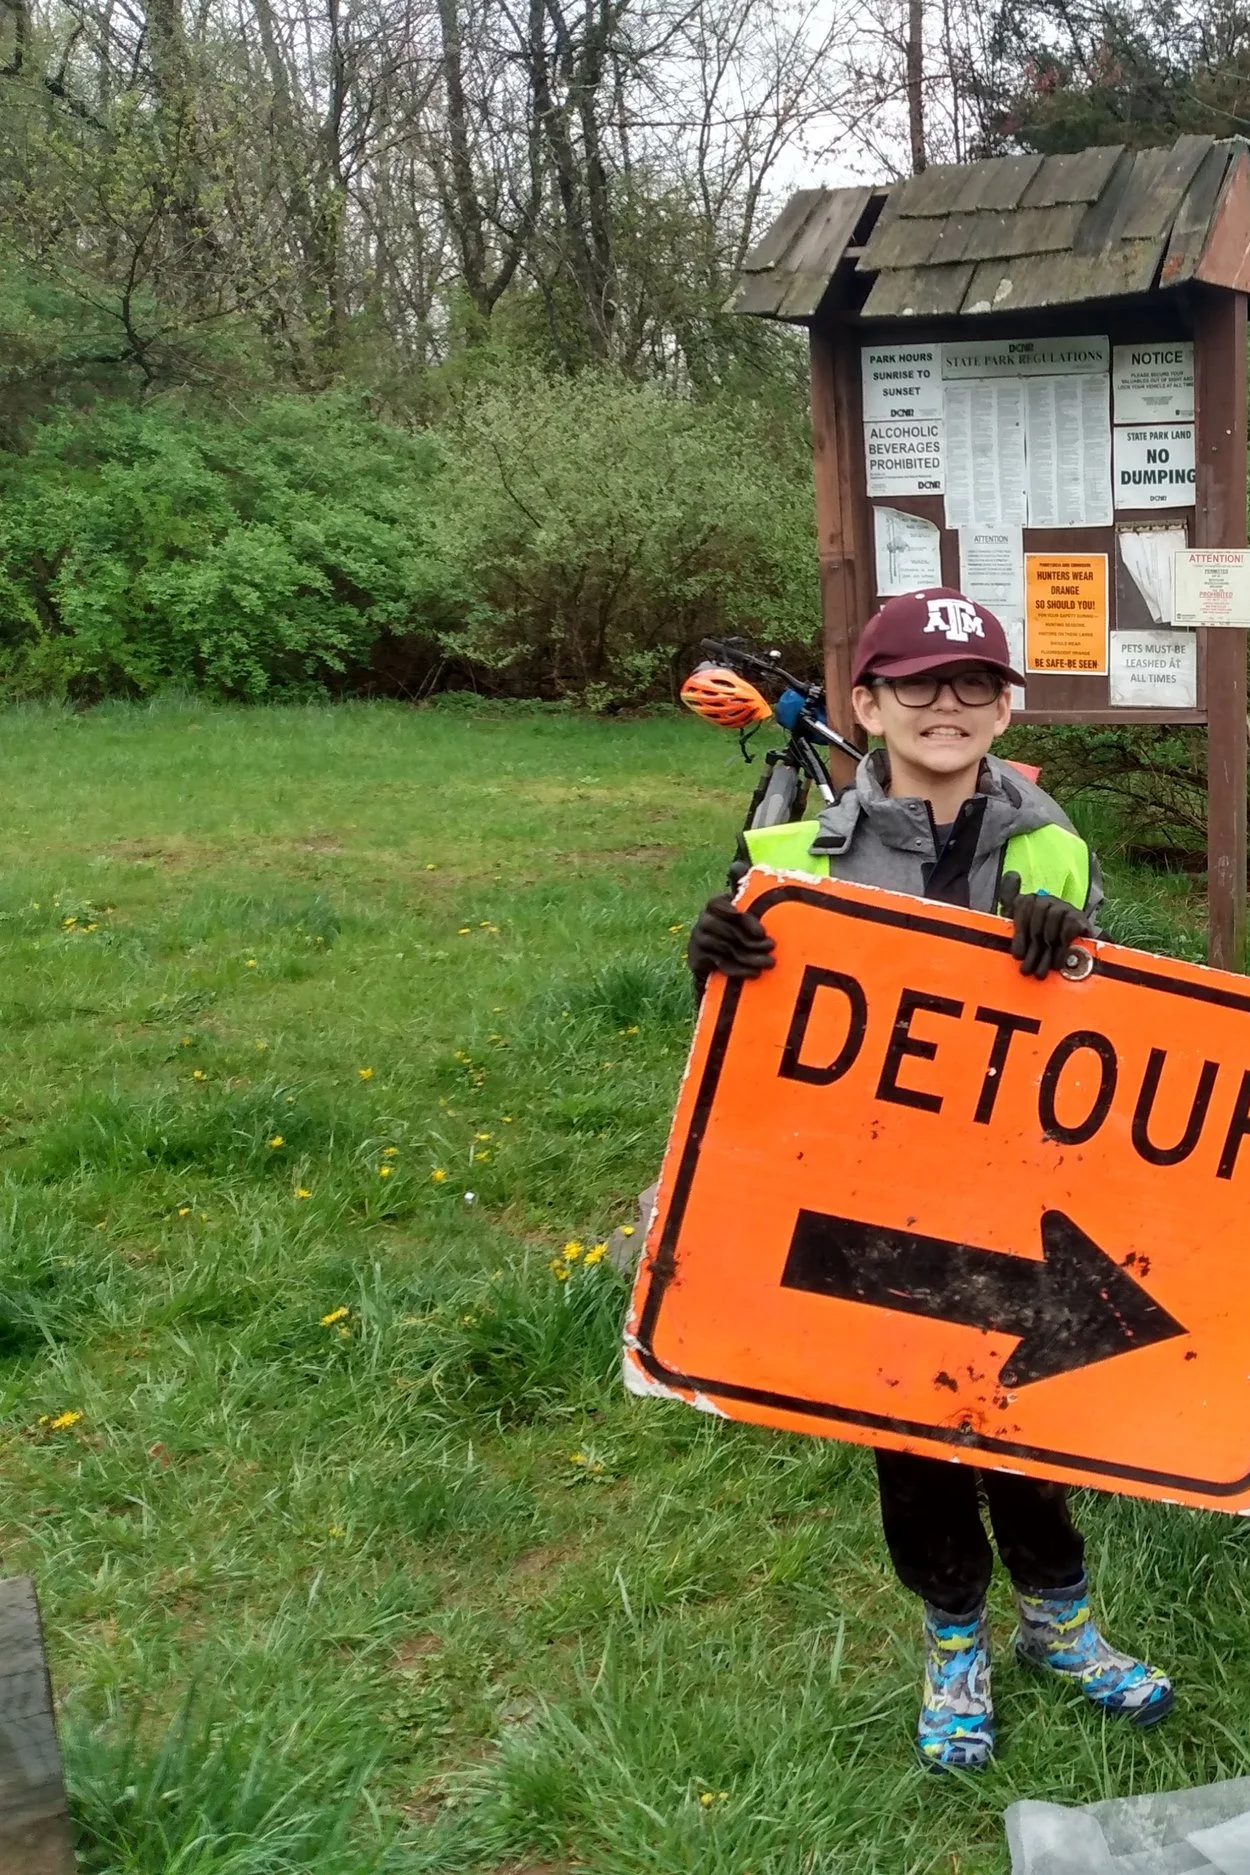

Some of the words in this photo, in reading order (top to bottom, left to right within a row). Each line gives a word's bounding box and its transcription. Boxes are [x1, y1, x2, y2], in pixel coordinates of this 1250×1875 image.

[870, 354, 896, 364] PARK
[899, 353, 933, 363] HOURS
[946, 357, 981, 367] STATE
[984, 355, 1015, 366] PARK
[1018, 351, 1103, 365] REGULATIONS
[1132, 350, 1183, 365] NOTICE
[873, 370, 914, 381] SUNRISE
[917, 370, 931, 379] TO
[882, 387, 921, 397] SUNSET
[870, 425, 939, 439] ALCOHOLIC
[1127, 432, 1148, 441] STATE
[1149, 431, 1169, 440] PARK
[1171, 430, 1192, 439] LAND
[868, 441, 941, 455] BEVERAGES
[1146, 448, 1170, 464] NO
[870, 457, 940, 470] PROHIBITED
[1121, 469, 1196, 485] DUMPING
[973, 535, 1009, 544] ATTENTION
[1189, 554, 1244, 563] ATTENTION!
[1036, 571, 1070, 580] HUNTERS
[1072, 571, 1094, 581] WEAR
[1050, 585, 1080, 595] ORANGE
[1035, 599, 1045, 609] SO
[1047, 600, 1075, 610] SHOULD
[1077, 600, 1095, 610] YOU!
[1121, 644, 1143, 653] PETS
[1145, 644, 1172, 654] MUST
[1174, 645, 1186, 654] BE
[1035, 658, 1045, 668] BE
[1078, 659, 1098, 669] SEEN
[1126, 658, 1167, 668] LEASHED
[1168, 657, 1181, 668] AT
[1130, 673, 1146, 682] ALL
[1148, 674, 1177, 683] TIMES
